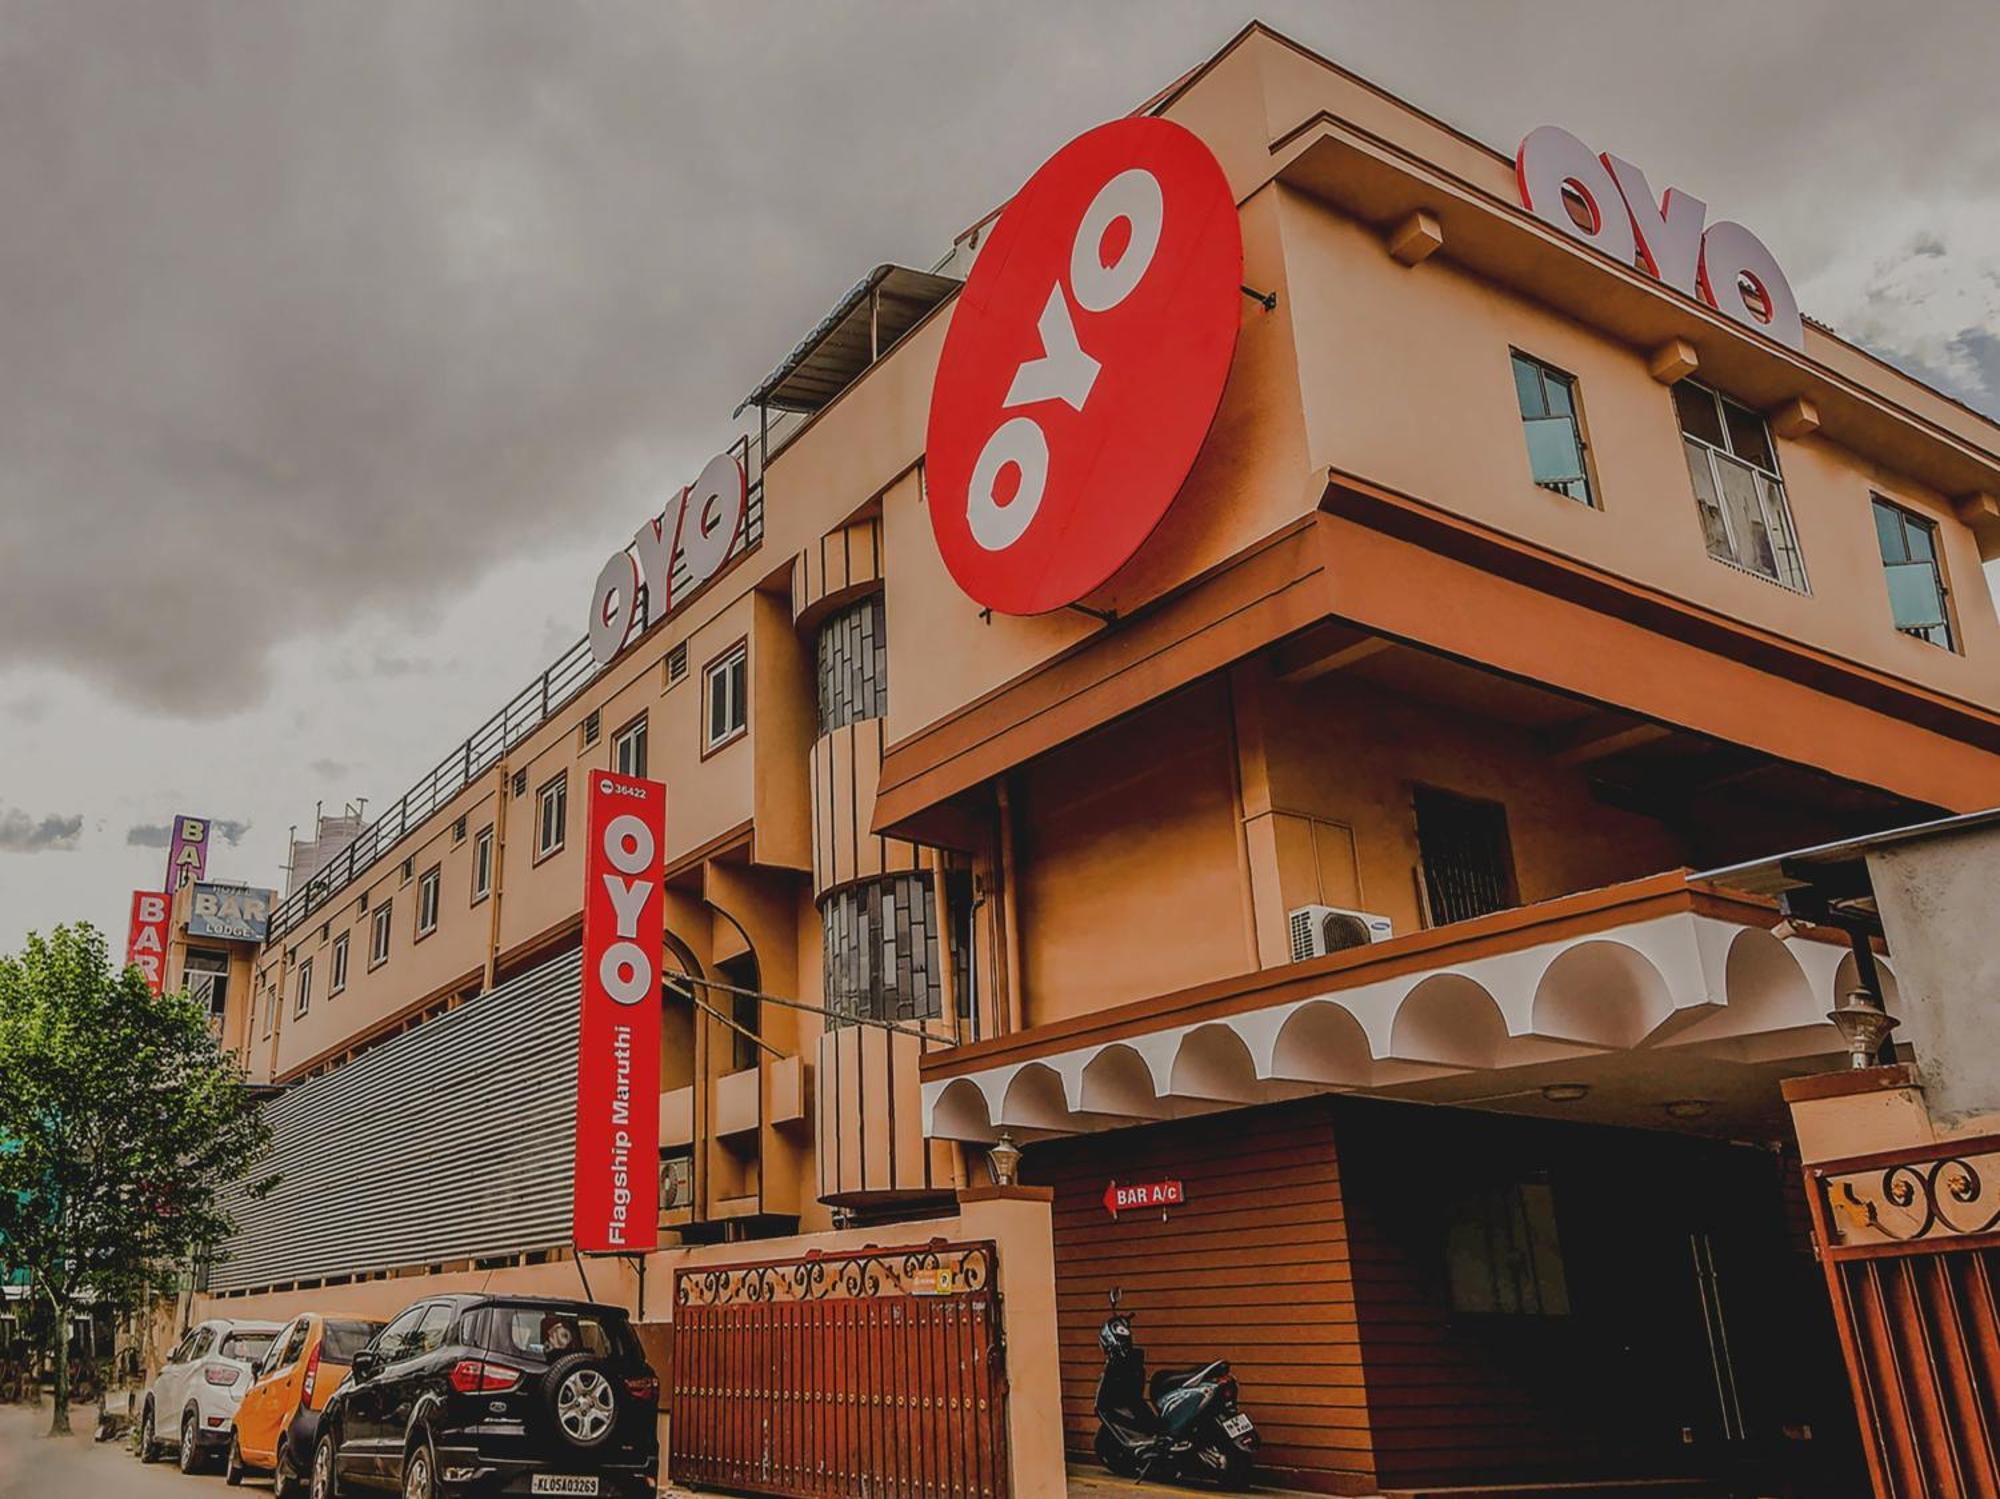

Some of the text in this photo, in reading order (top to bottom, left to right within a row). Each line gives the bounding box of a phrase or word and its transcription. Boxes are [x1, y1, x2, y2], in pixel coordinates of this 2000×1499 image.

[1516, 124, 1805, 352] OYO
[966, 168, 1164, 552] OYO
[589, 453, 746, 663] OYO
[133, 896, 165, 982] BAR
[195, 893, 267, 922] BAR
[205, 923, 253, 937] LODGE
[599, 814, 655, 1003] OYO
[608, 1025, 632, 1245] Flagship Maruthi
[1117, 1188, 1148, 1205] BAR
